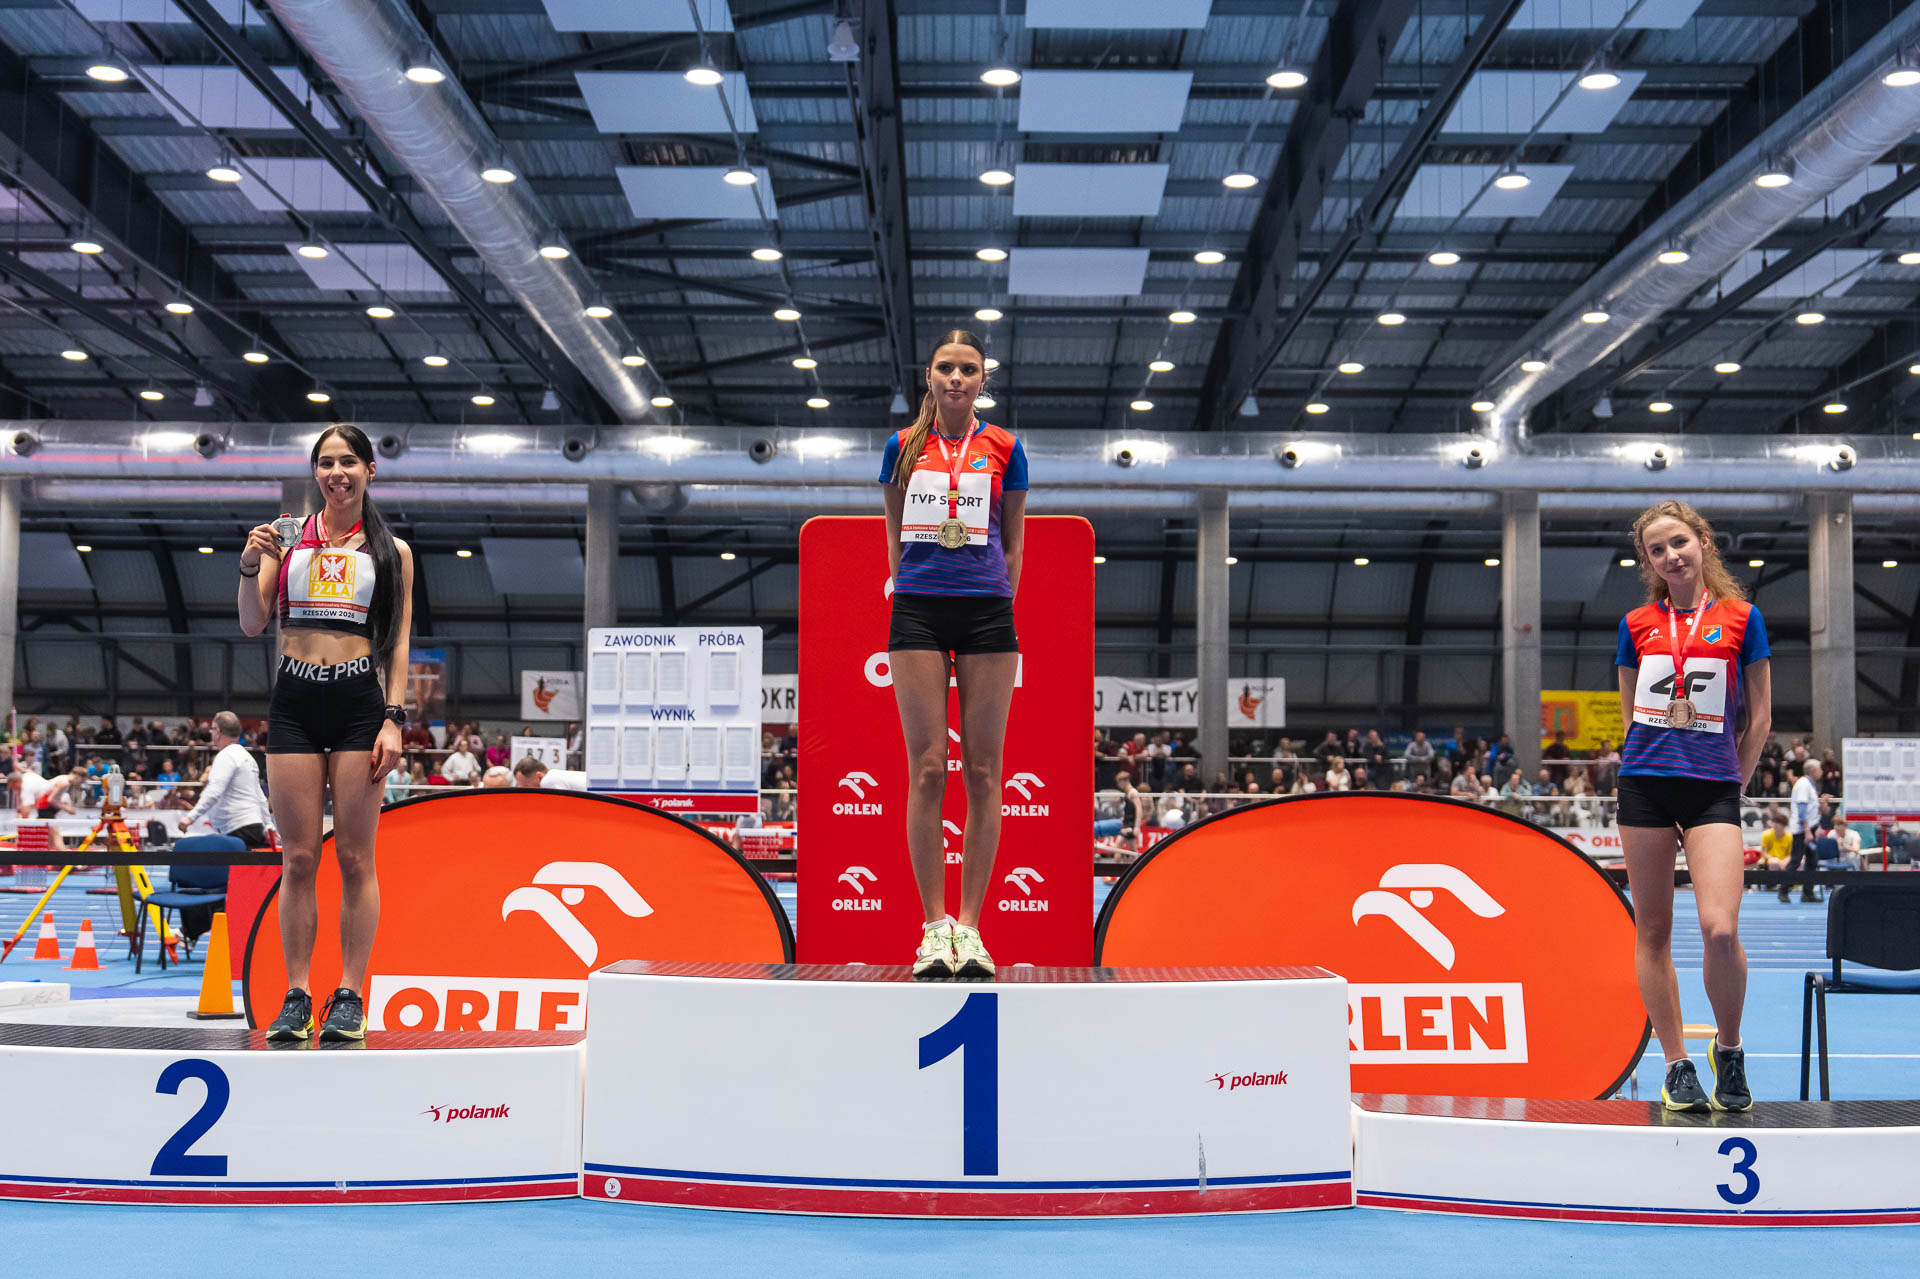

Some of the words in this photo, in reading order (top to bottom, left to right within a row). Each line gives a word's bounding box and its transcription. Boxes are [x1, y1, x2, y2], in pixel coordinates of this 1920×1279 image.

[910, 493, 936, 504] TVP
[939, 495, 983, 507] SORT
[914, 533, 939, 541] RZESZ
[311, 582, 351, 597] PZLA
[302, 609, 337, 617] RZESZÓW
[338, 610, 355, 619] 2026
[604, 634, 676, 647] ZAWODNIK
[699, 631, 745, 646] PRÓBA
[286, 660, 331, 682] NIKE
[334, 656, 370, 680] PRO
[1649, 671, 1717, 700] 4F
[650, 709, 696, 721] WYNIK
[1648, 717, 1667, 725] RZES
[1690, 721, 1707, 729] 026
[660, 799, 695, 809] polanik
[832, 803, 882, 815] ORLEN
[1000, 804, 1049, 817] ORLEN
[1591, 835, 1622, 848] ORL
[831, 898, 881, 911] ORLEN
[998, 900, 1048, 912] ORLEN
[383, 987, 588, 1032] ORLE
[1347, 996, 1507, 1051] LEN
[918, 992, 998, 1176] 1
[1230, 1069, 1289, 1091] polanik
[150, 1058, 230, 1177] 2
[446, 1103, 511, 1123] polanik
[1715, 1136, 1761, 1205] 3
